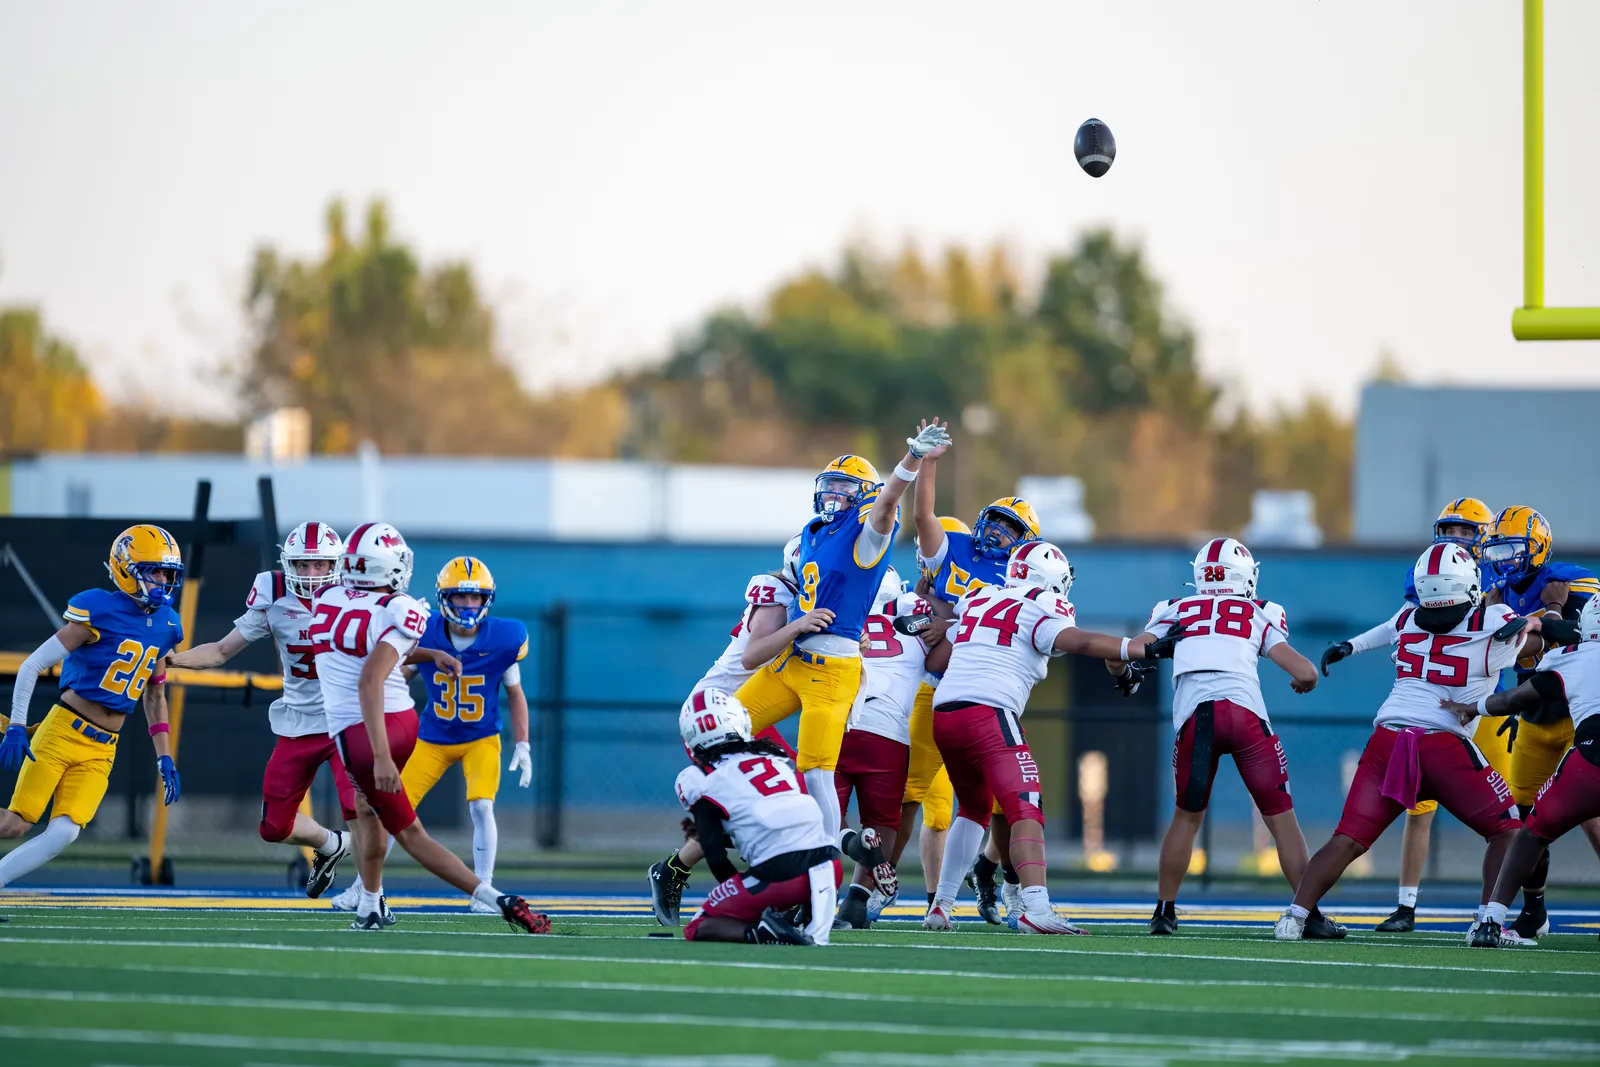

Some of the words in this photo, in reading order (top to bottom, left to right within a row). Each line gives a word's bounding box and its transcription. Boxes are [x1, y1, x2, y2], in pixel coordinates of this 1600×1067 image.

[798, 561, 821, 614] 9
[1009, 561, 1029, 580] 63
[1203, 565, 1226, 582] 28
[246, 586, 257, 607] 0
[747, 585, 776, 604] 43
[1424, 599, 1455, 609] Riddell
[309, 603, 373, 659] 20
[402, 608, 427, 635] 20
[863, 613, 904, 659] 8
[953, 596, 1024, 648] 54
[1176, 598, 1255, 640] 28
[98, 638, 160, 702] 26
[285, 643, 319, 680] 3
[1396, 632, 1473, 688] 55
[433, 671, 486, 723] 35
[695, 713, 717, 734] 10
[738, 756, 793, 797] 2
[1015, 751, 1041, 784] SIDE
[1486, 770, 1513, 804] SIDE
